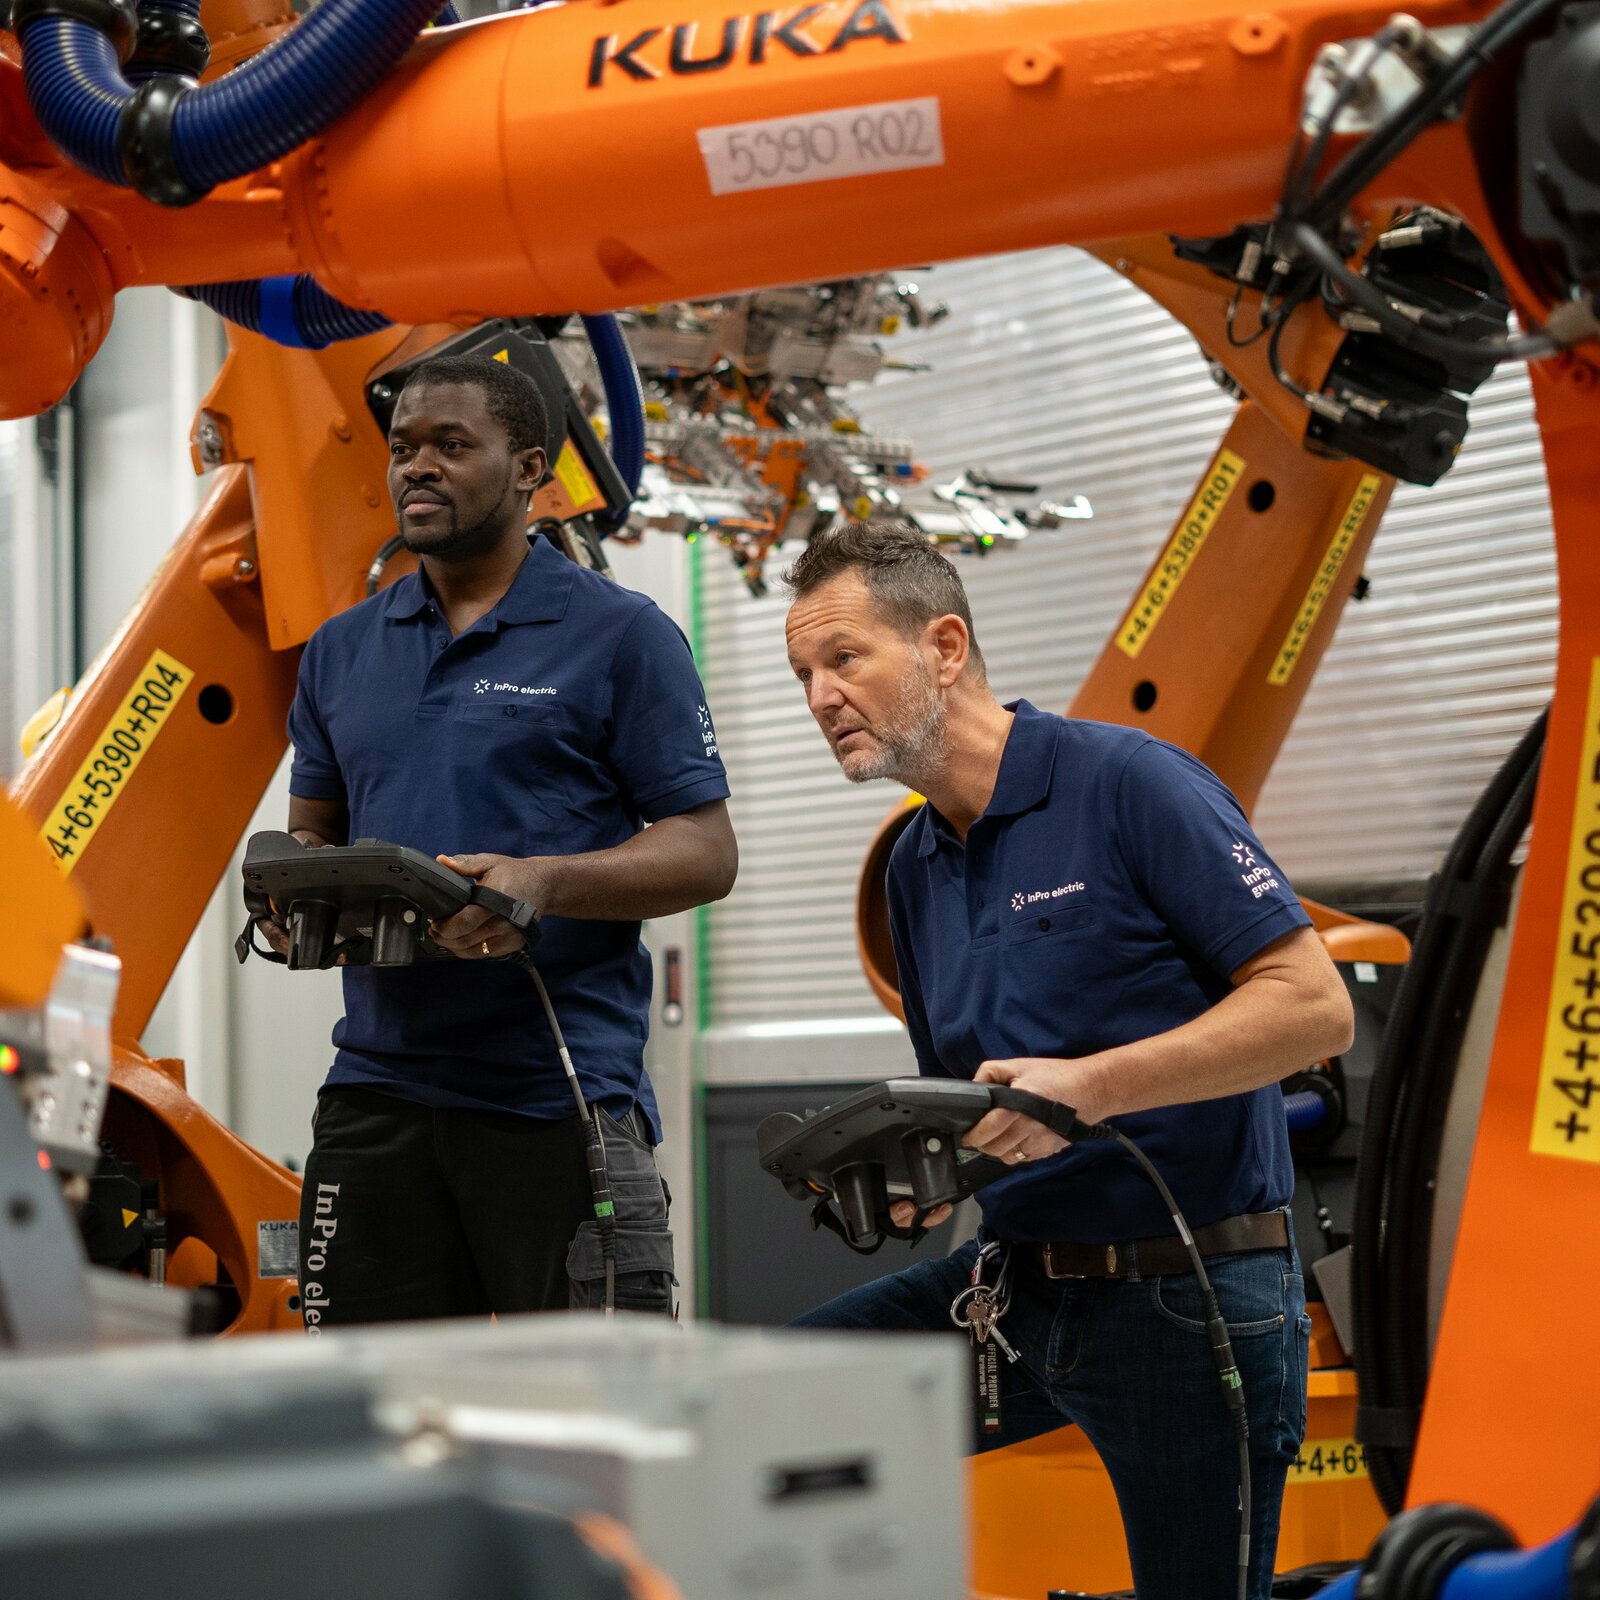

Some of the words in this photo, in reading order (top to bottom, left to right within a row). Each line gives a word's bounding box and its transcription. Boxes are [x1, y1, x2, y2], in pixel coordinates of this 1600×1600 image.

[586, 0, 910, 89] KUKA
[727, 120, 838, 184] 5390
[852, 107, 935, 160] R02
[493, 682, 519, 692] InPro
[520, 686, 557, 695] electric
[1241, 867, 1271, 886] InPro
[1251, 878, 1279, 899] group
[1027, 891, 1050, 903] InPro
[1051, 881, 1085, 898] electric
[260, 1221, 299, 1231] KUKA
[307, 1183, 340, 1271] InPro
[987, 1344, 998, 1373] OFFICIAL
[988, 1375, 999, 1408] PROVIDER
